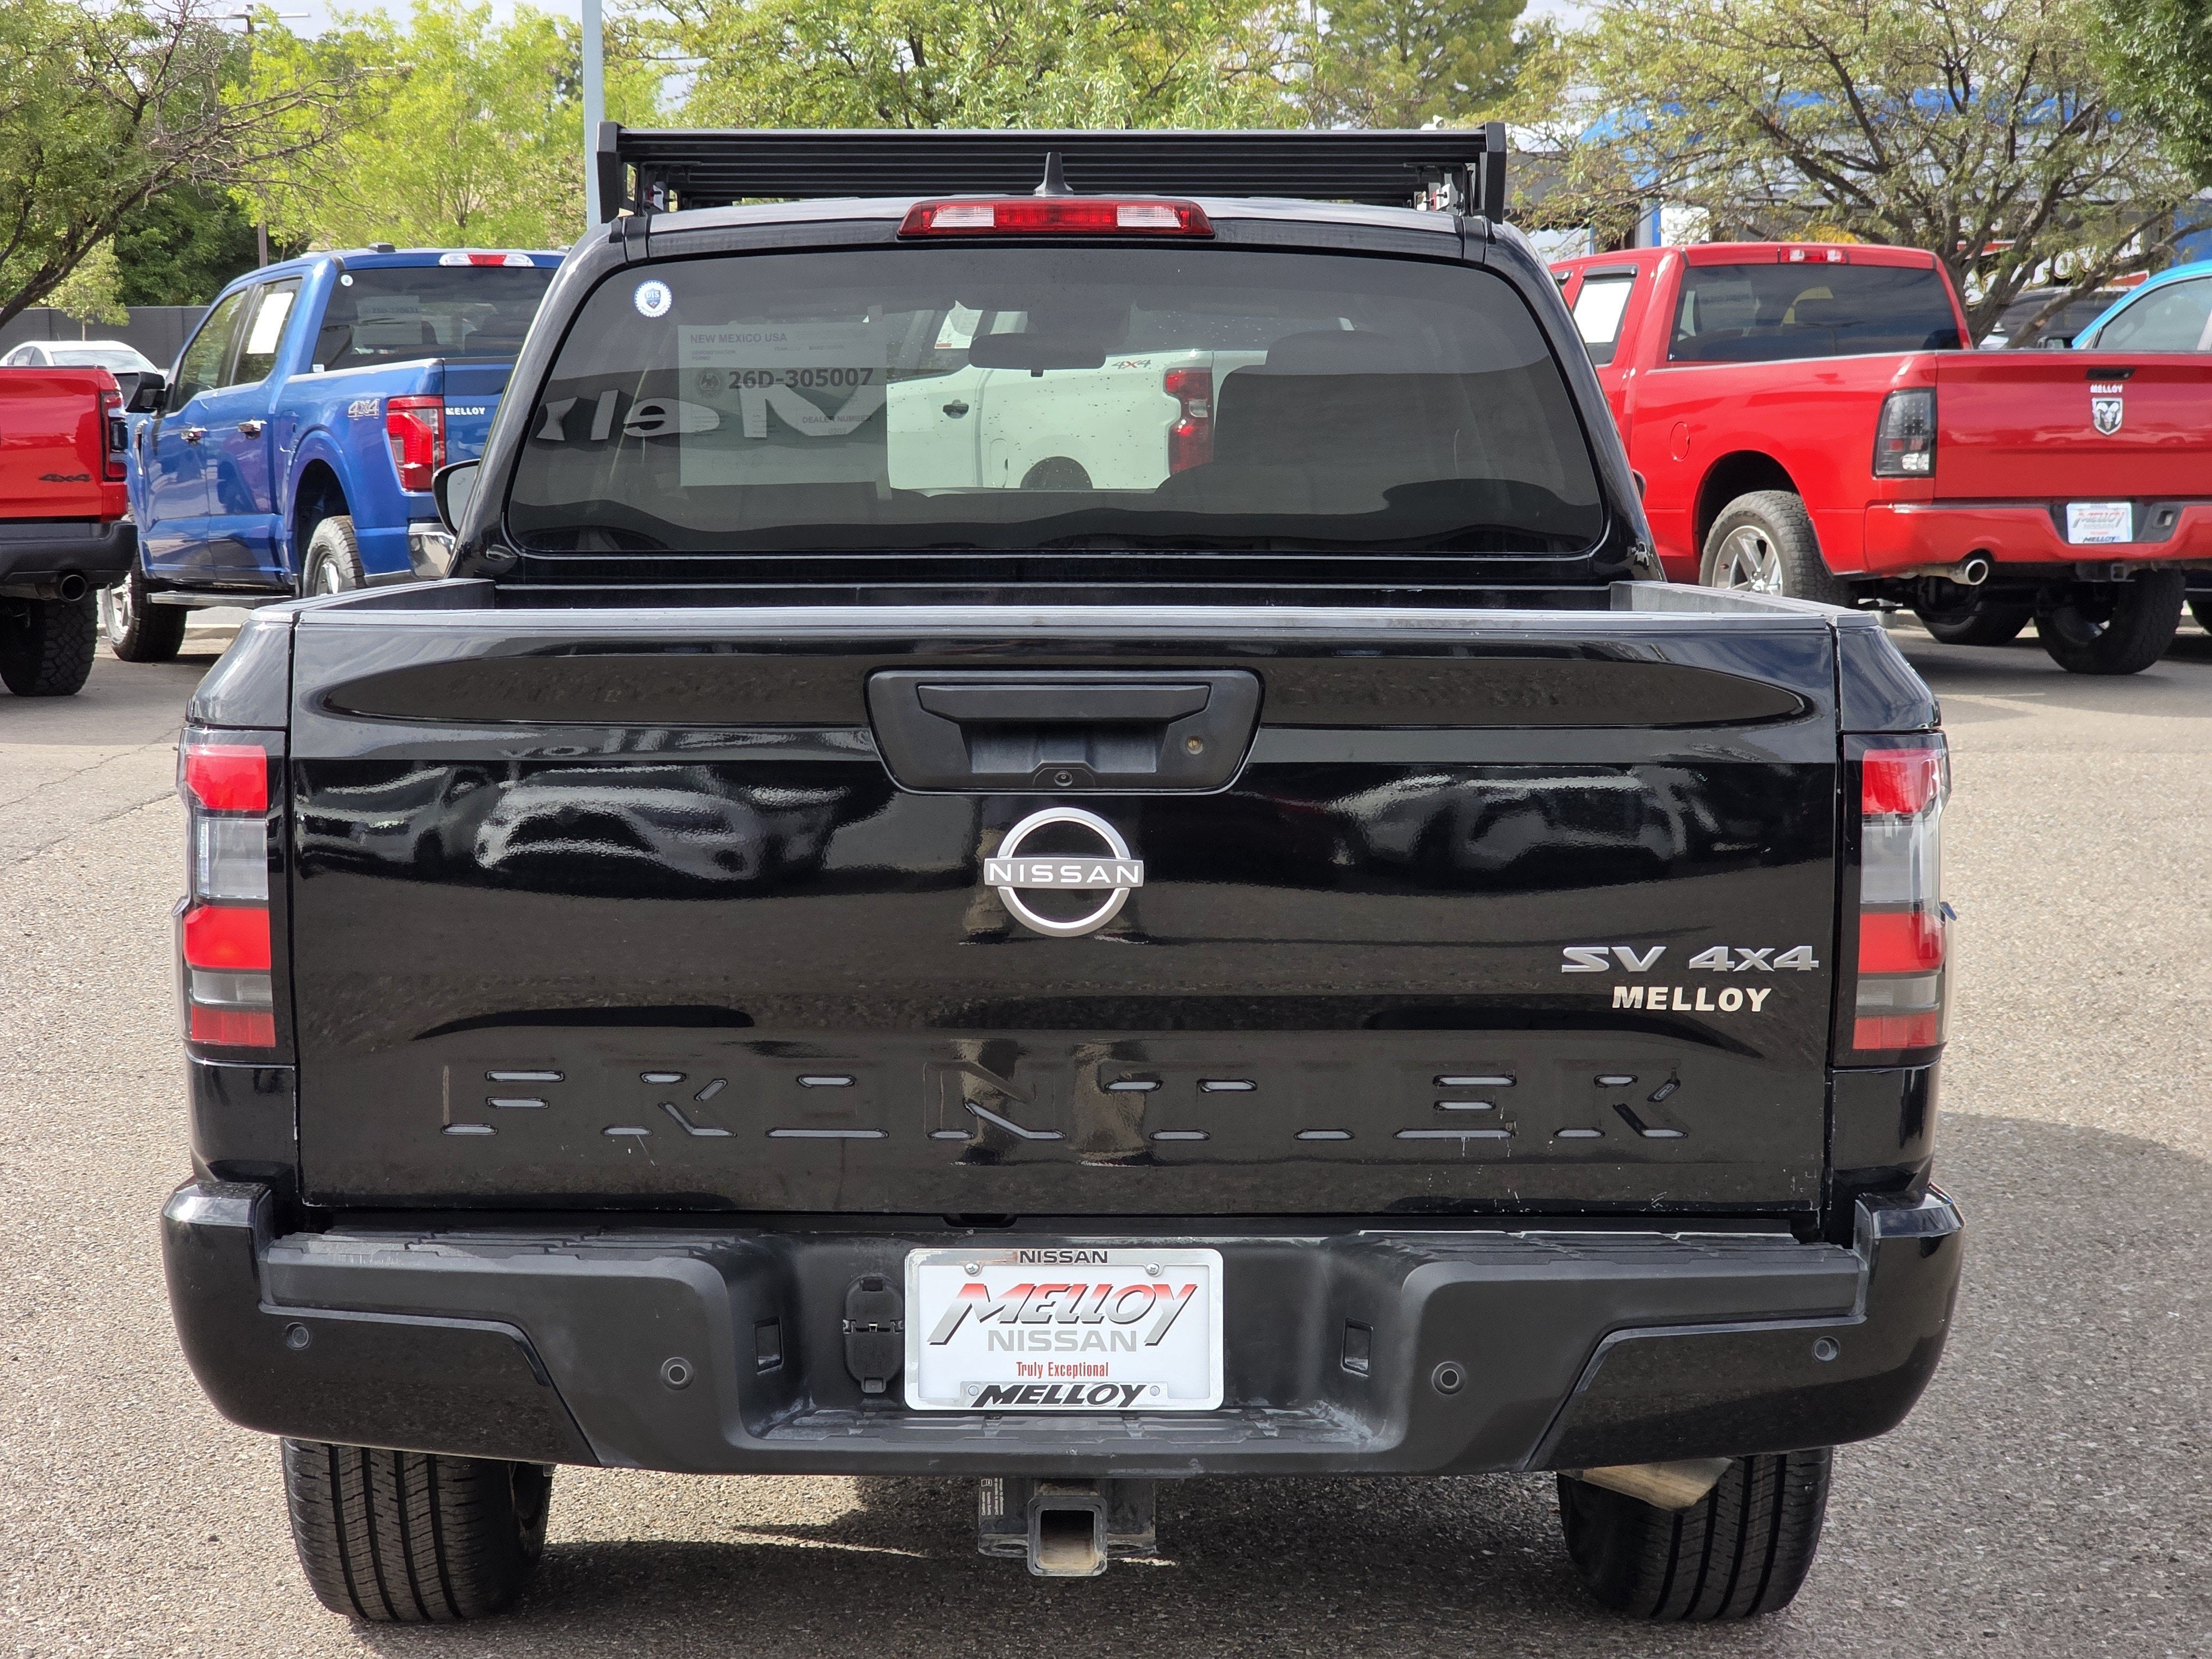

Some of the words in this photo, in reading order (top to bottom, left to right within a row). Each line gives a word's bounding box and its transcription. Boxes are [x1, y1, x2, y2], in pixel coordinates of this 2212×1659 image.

[645, 290, 660, 299] DIS
[690, 334, 716, 343] NEW
[718, 333, 761, 343] MEXICO
[764, 332, 787, 342] USA
[728, 368, 874, 389] 26D-305007
[2090, 384, 2123, 393] MELLOY
[445, 406, 486, 415] MELLOY
[802, 415, 835, 424] DEALER
[989, 862, 1140, 884] NISSAN
[1561, 946, 1667, 973] SV
[1688, 945, 1819, 972] 4x4
[1612, 985, 1772, 1013] MELLOY
[1019, 1250, 1109, 1264] NISSAN
[926, 1282, 1198, 1347] MELLOY
[987, 1329, 1138, 1352] NISSAN
[1016, 1361, 1044, 1379] Truly
[1048, 1361, 1109, 1379] Exceptional
[971, 1384, 1147, 1408] MELLOY
